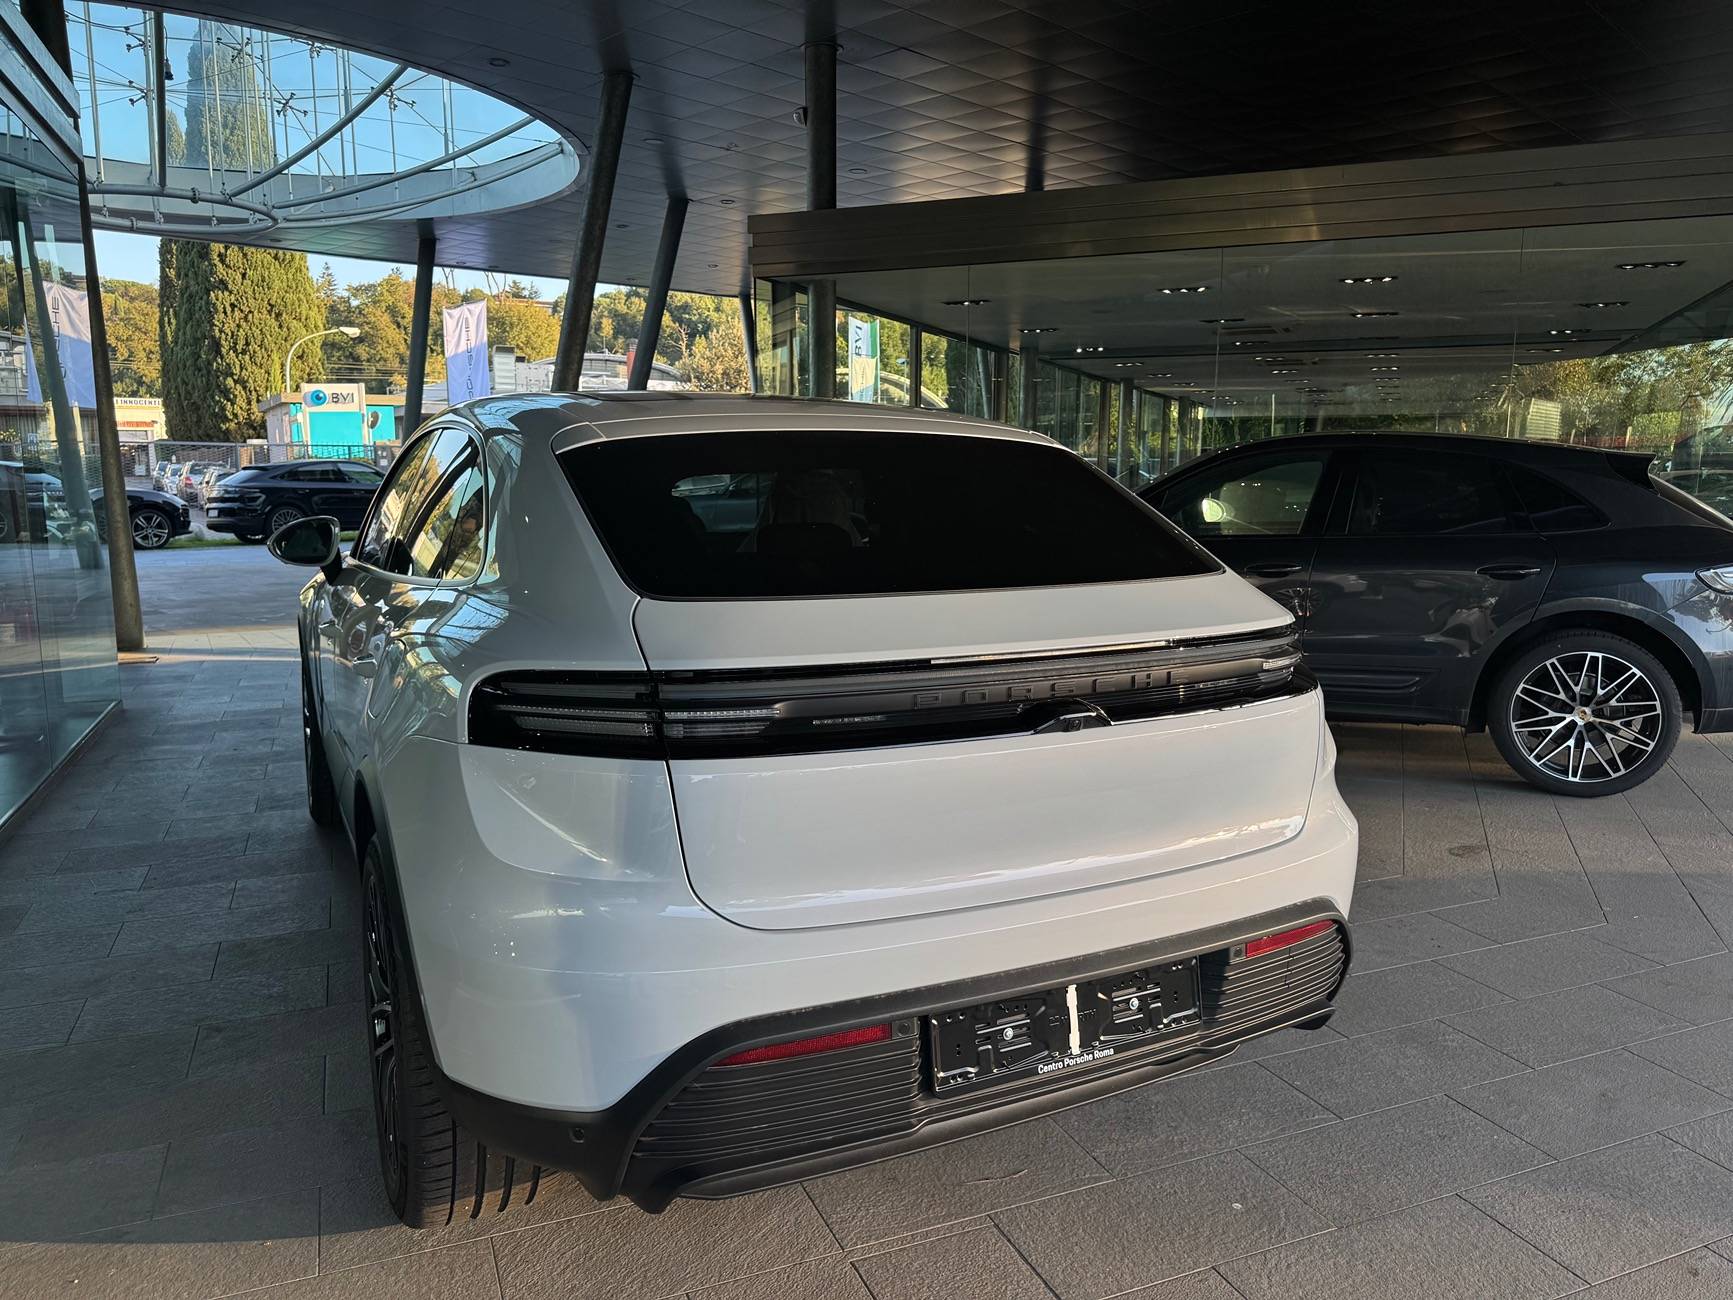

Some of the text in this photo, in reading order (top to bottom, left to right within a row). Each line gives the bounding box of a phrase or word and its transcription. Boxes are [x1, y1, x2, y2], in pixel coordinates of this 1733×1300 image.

[331, 392, 354, 403] BVI
[913, 670, 1185, 709] PORSCHE
[1037, 1048, 1115, 1074] Centro Porsche Roma
